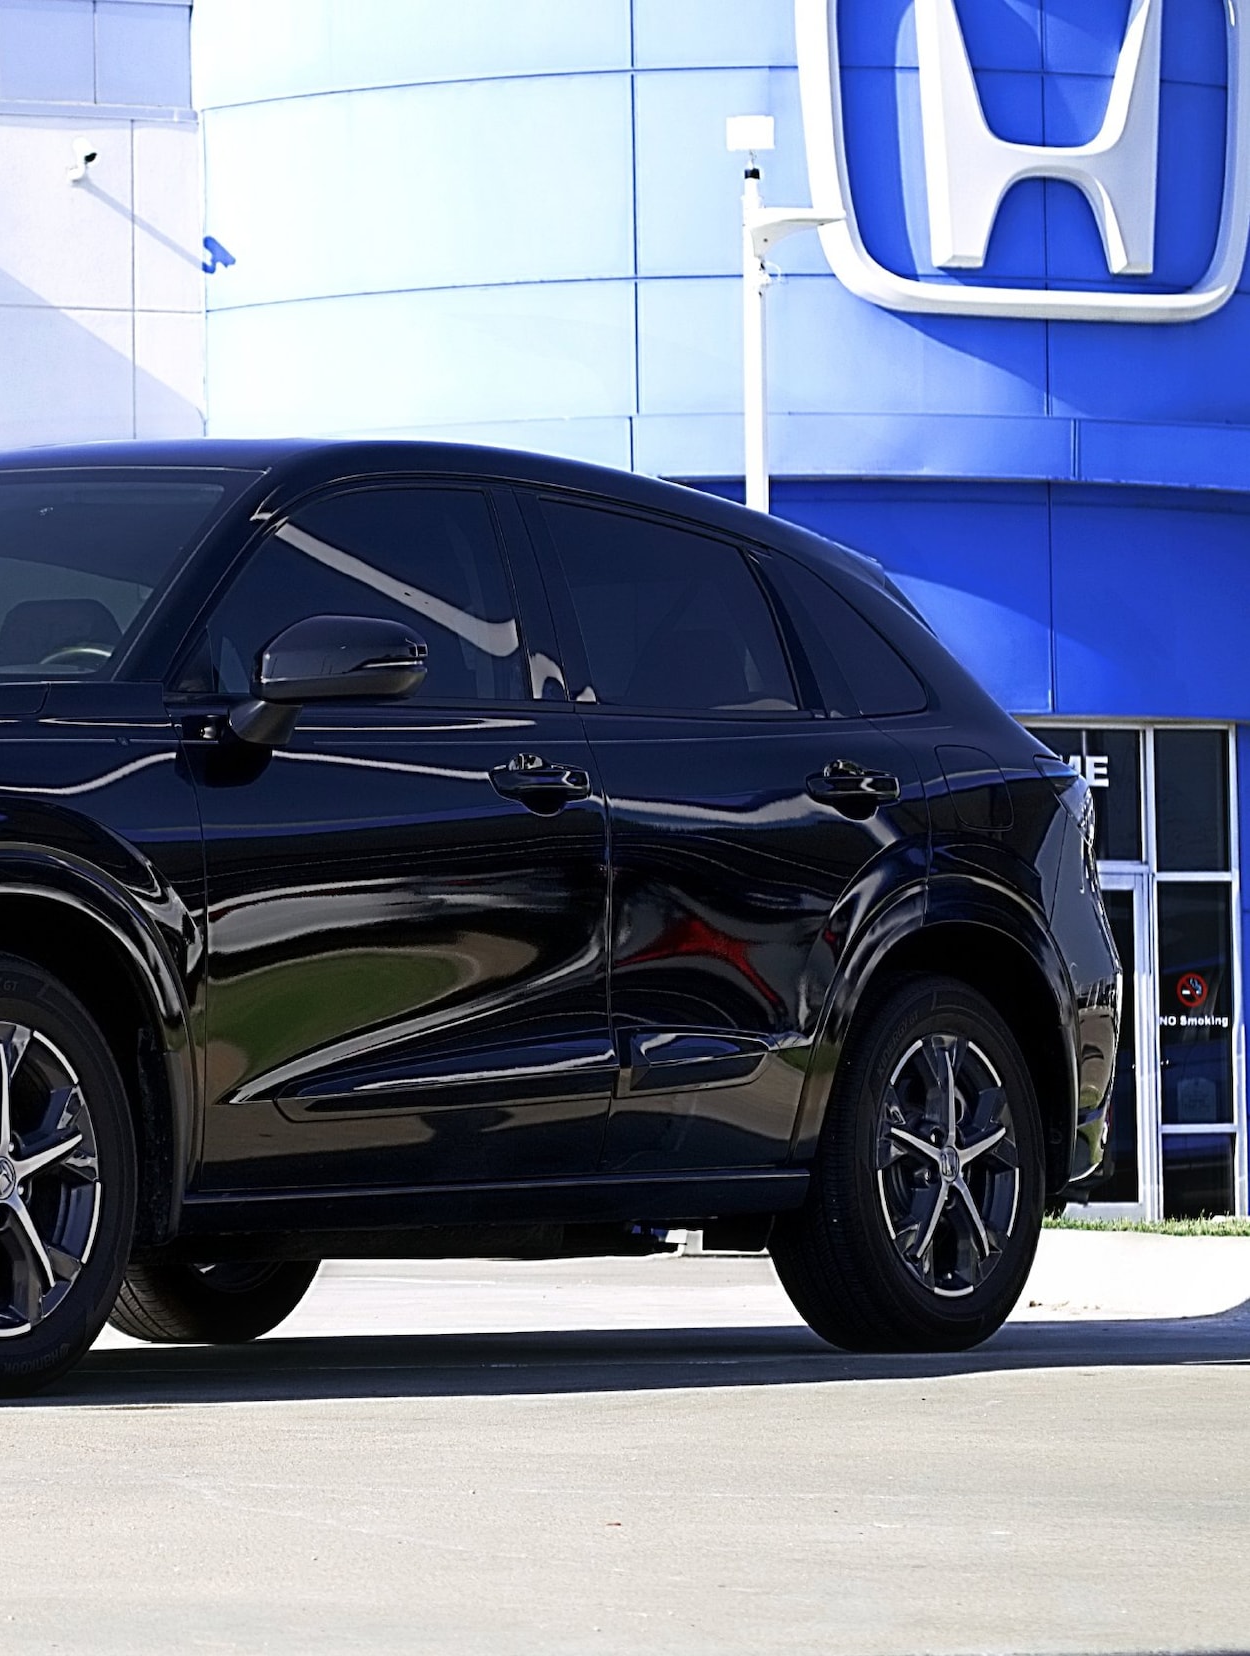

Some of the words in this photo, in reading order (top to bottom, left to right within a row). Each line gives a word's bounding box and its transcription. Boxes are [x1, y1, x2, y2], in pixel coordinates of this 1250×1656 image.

[3, 979, 19, 991] GT
[1159, 1015, 1177, 1026] NO
[1180, 1014, 1229, 1028] Smoking
